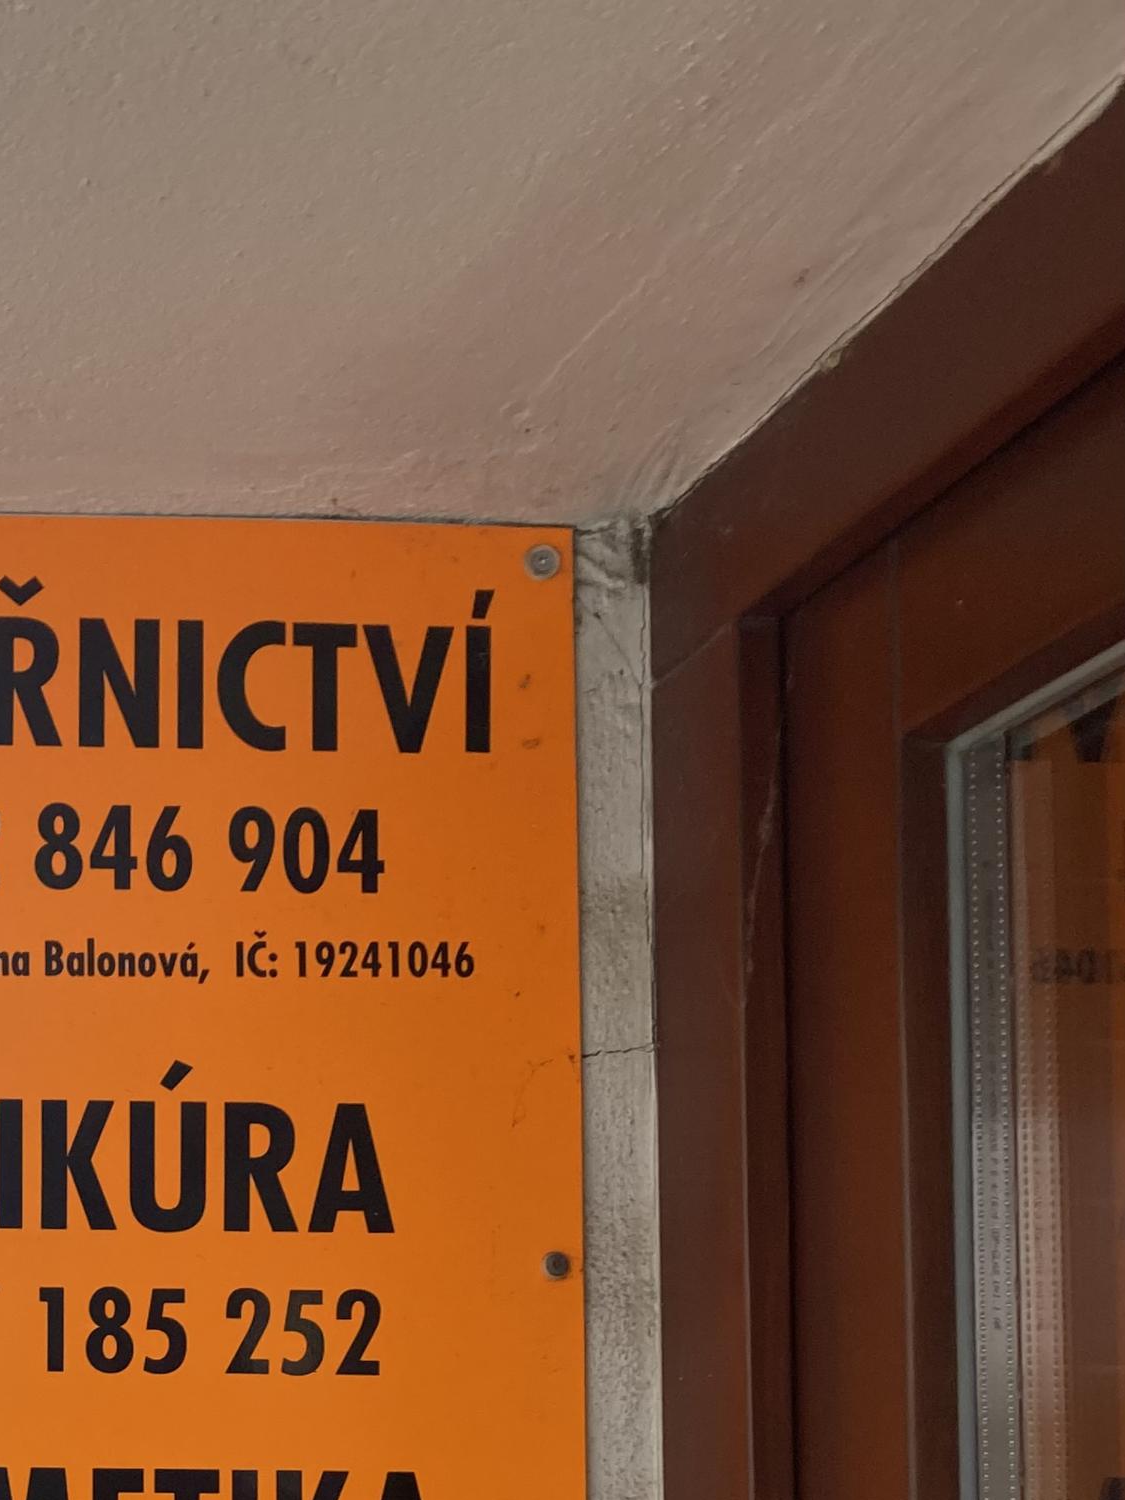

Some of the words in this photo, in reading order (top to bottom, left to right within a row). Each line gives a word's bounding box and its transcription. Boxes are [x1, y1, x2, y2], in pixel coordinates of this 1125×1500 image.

[34, 803, 193, 892] 846
[228, 806, 385, 895] 904
[44, 937, 210, 984] Balonová,
[235, 931, 278, 978] IČ:
[295, 940, 475, 978] 19241046
[38, 1286, 188, 1375] 185
[225, 1288, 382, 1377] 252
